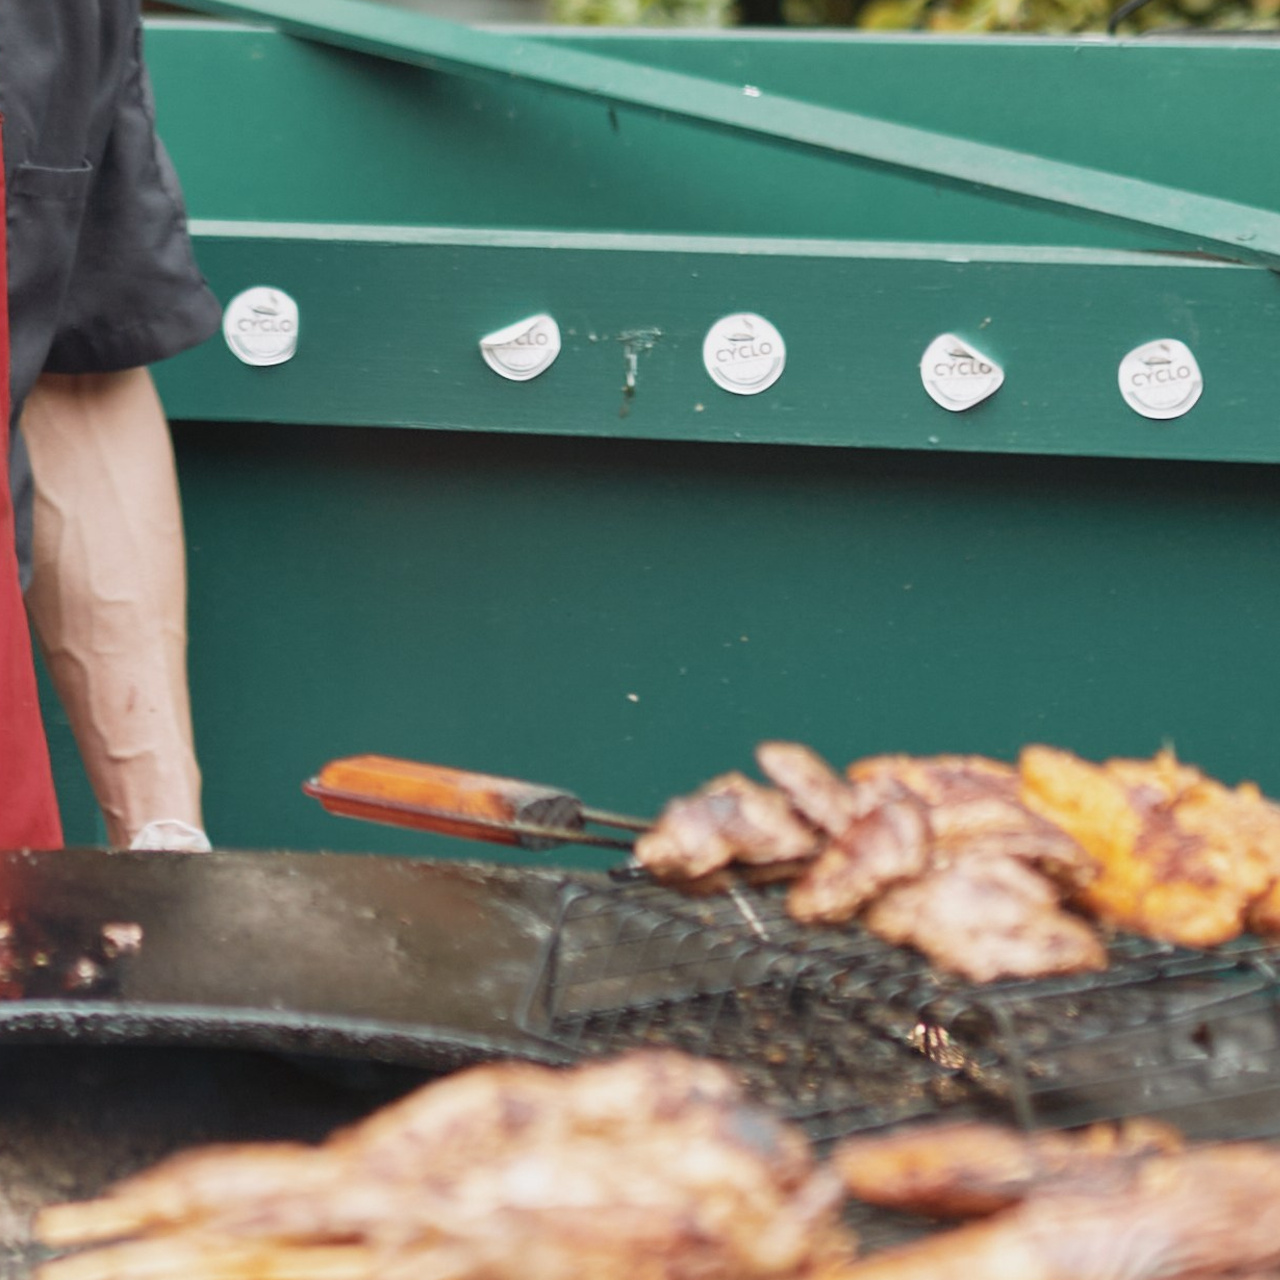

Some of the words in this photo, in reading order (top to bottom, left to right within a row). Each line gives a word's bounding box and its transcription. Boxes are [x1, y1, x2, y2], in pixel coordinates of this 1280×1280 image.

[238, 318, 292, 332] CYCLO
[716, 342, 772, 362] CYCLO
[934, 361, 992, 376] CYCLO
[1131, 365, 1190, 386] CYCLO
